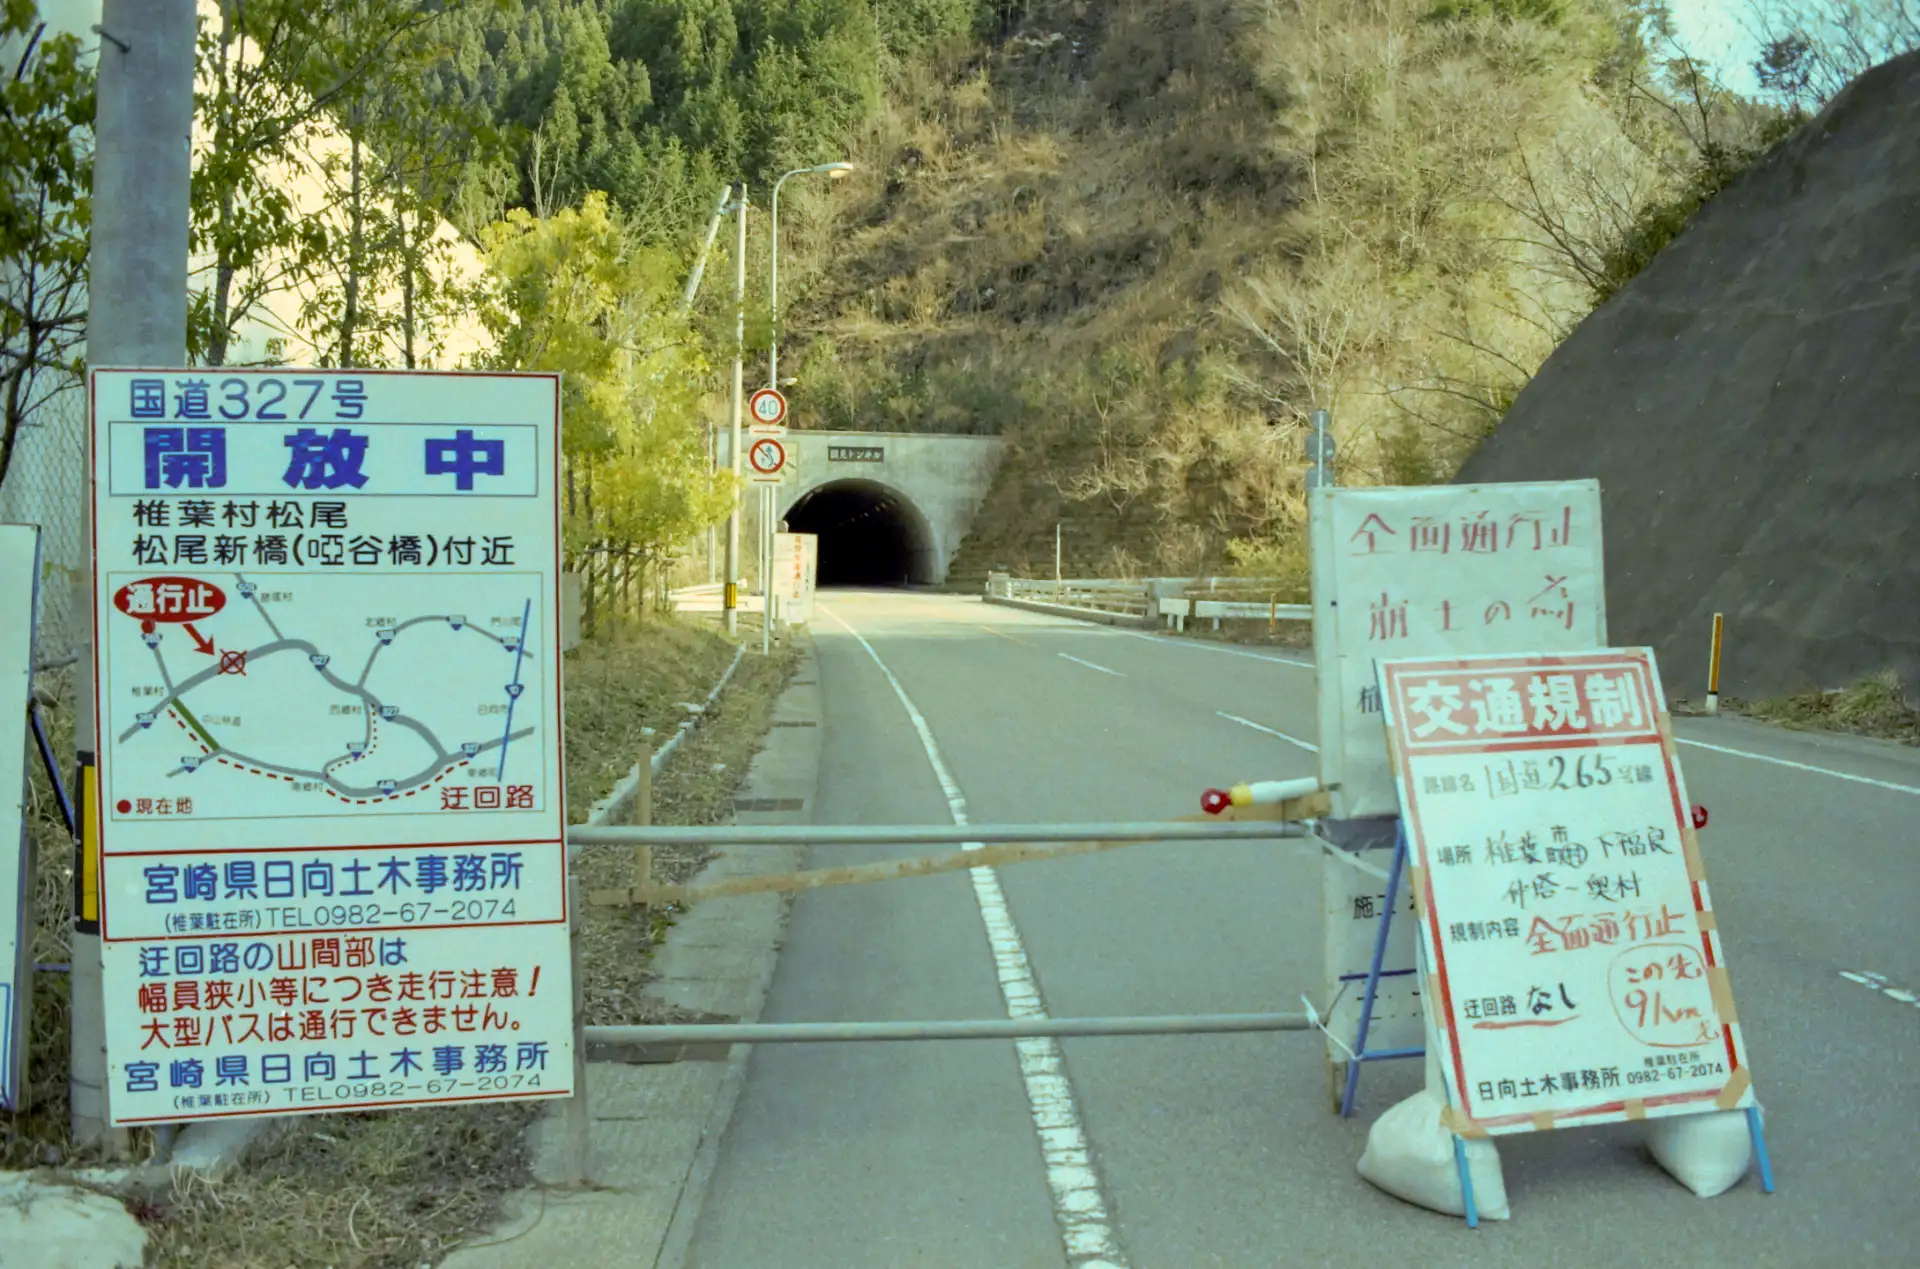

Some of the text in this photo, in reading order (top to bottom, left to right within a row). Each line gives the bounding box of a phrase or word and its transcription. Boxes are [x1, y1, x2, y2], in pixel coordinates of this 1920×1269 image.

[131, 378, 369, 420] 国道327号
[759, 400, 777, 415] 40
[143, 427, 505, 491] 開放中
[132, 500, 348, 529] 椎葉村松尾
[126, 583, 215, 614] 通行止
[1407, 671, 1644, 738] 交通規制
[135, 797, 193, 815] 現在地
[440, 784, 535, 810] 迂回路
[143, 851, 525, 905] 宮崎県日向土木事務所
[1450, 917, 1520, 943] 規制内容
[138, 936, 408, 977] 迂回路の山間部は
[1464, 982, 1577, 1020] 迂回路 なし
[140, 1002, 522, 1050] 大型バスは通行できません。
[124, 1041, 550, 1093] 宮崎県日向土木事務所
[1477, 1062, 1724, 1102] 日向土木事務所 0982-67-2074
